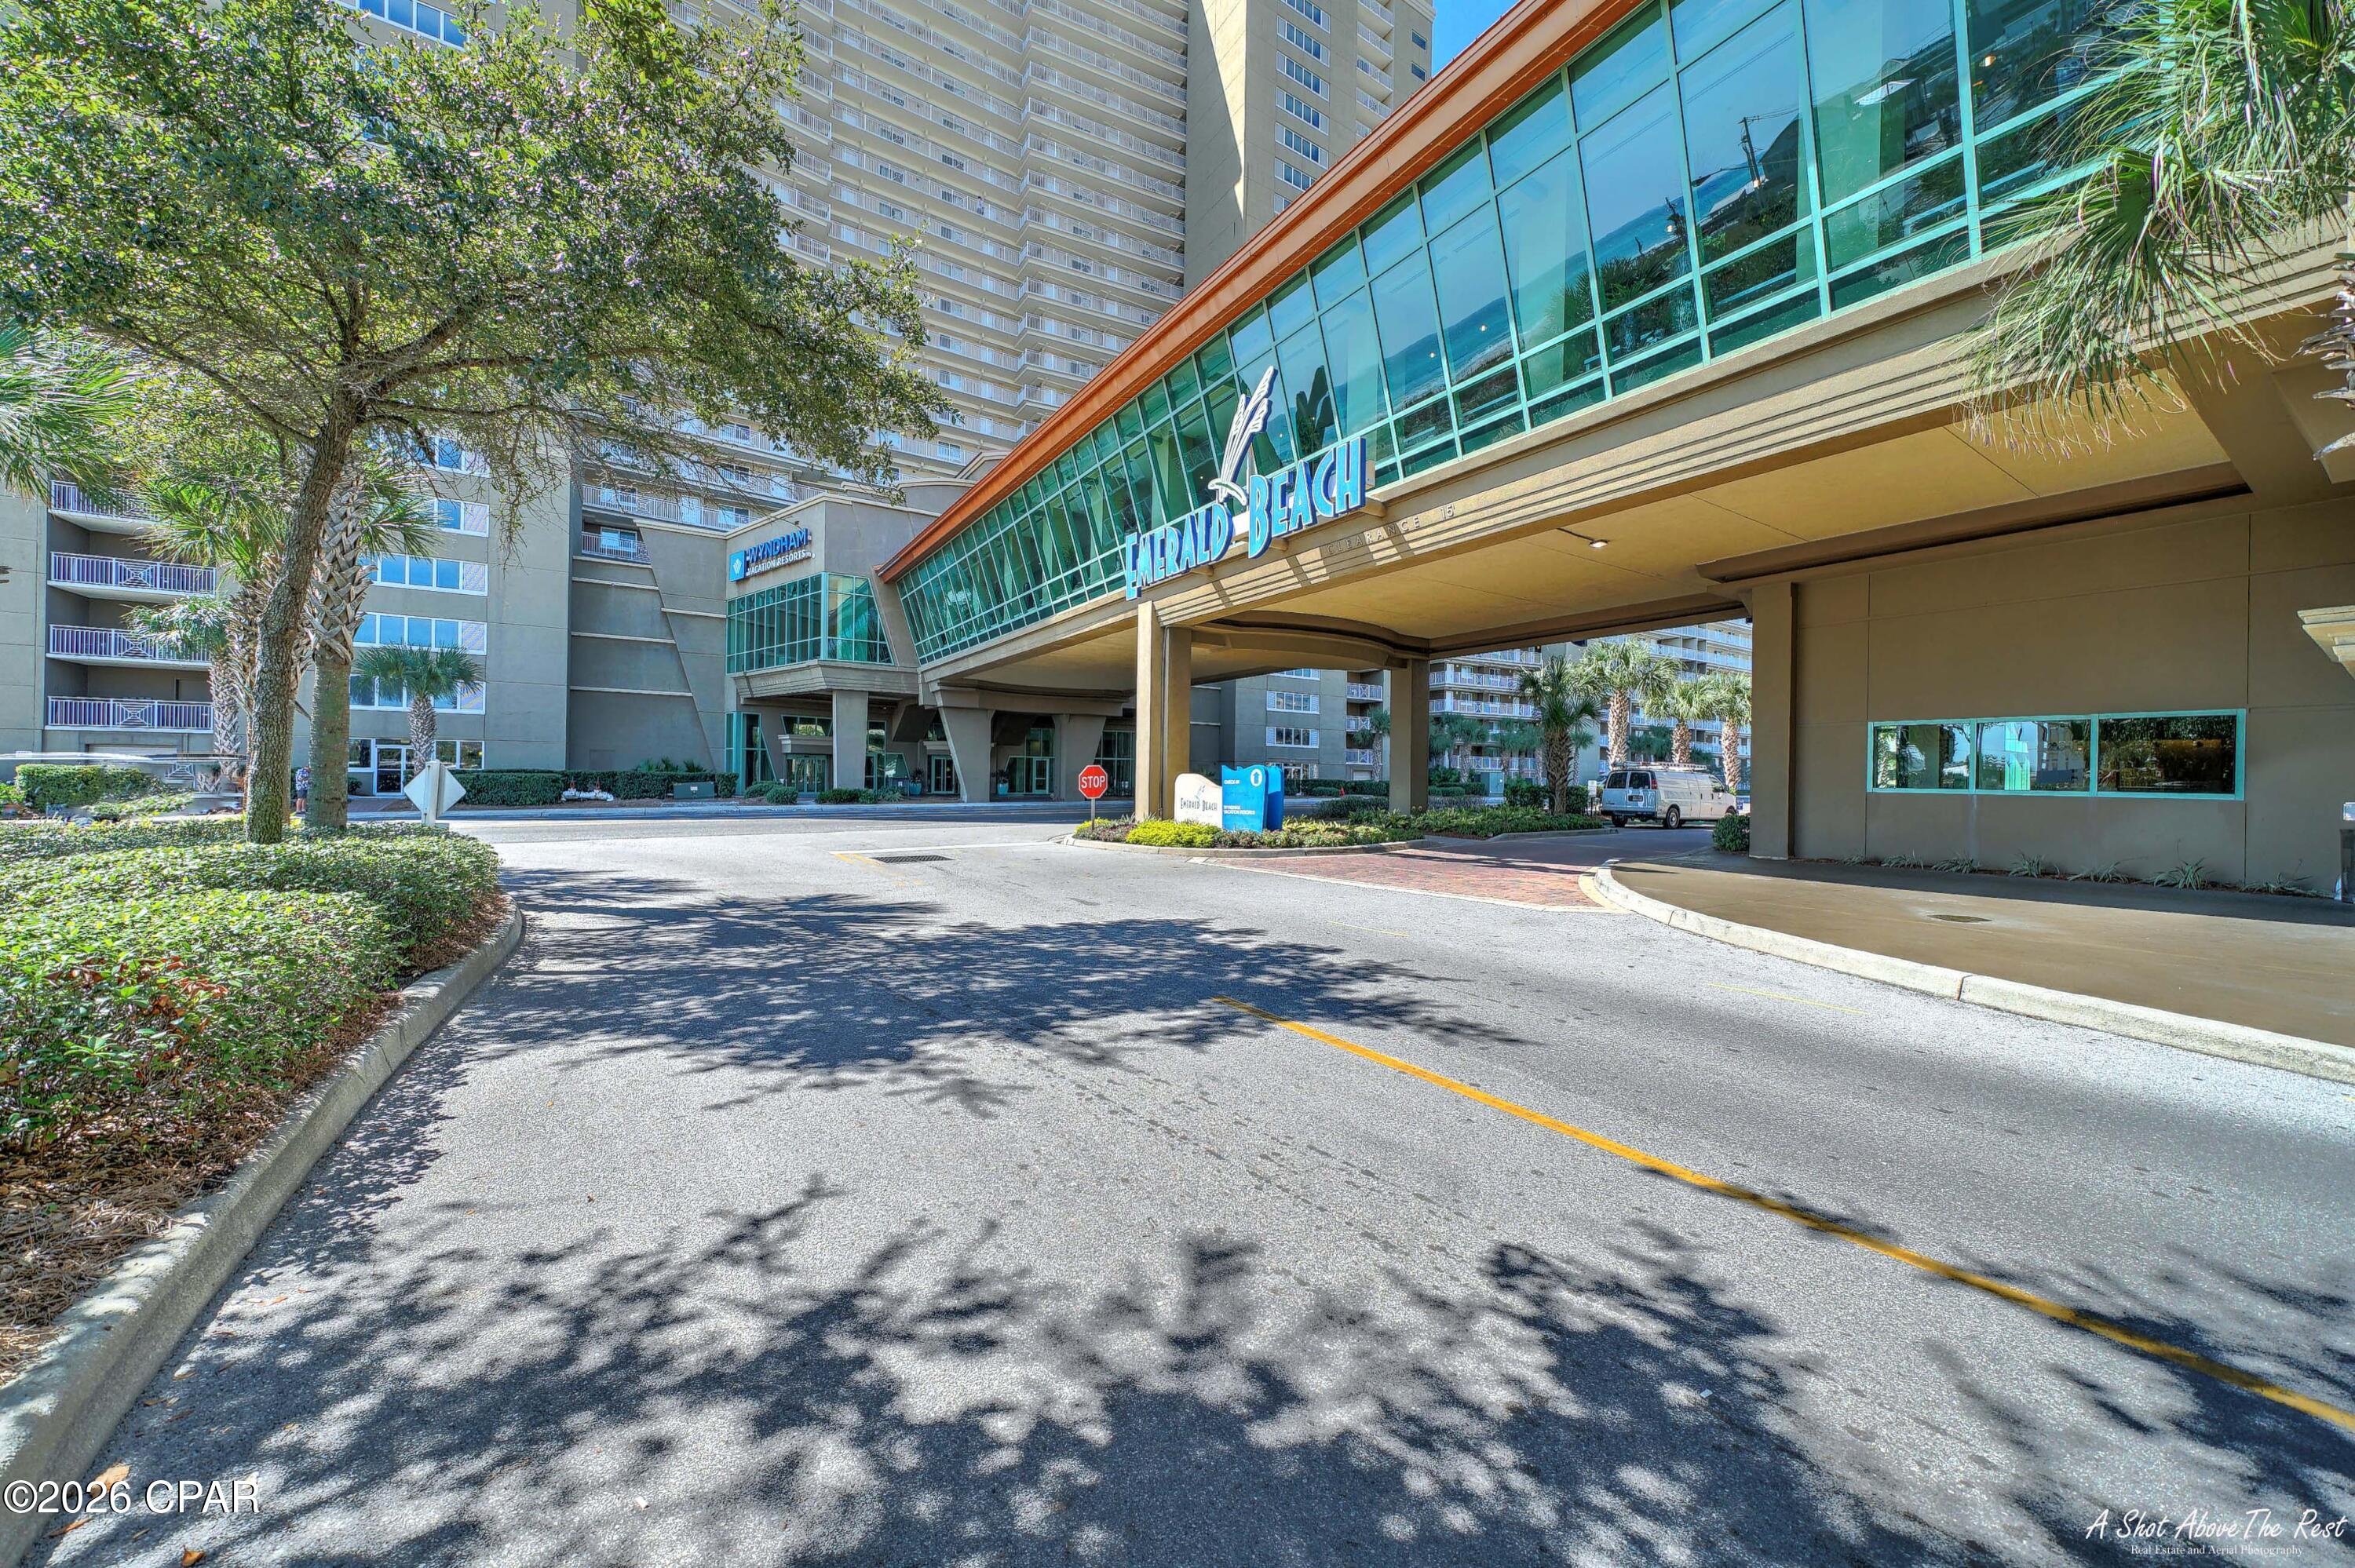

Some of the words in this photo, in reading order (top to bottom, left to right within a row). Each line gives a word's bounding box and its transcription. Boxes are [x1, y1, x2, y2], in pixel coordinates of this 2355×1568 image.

[1126, 502, 1234, 601] EMERALD
[1248, 436, 1367, 559] BEACH
[747, 527, 809, 563] WYNDHAM
[1326, 516, 1421, 554] CLEARANCE
[747, 560, 776, 577] VACATION
[776, 549, 806, 567] RESORTS
[1081, 775, 1105, 789] STOP
[1180, 797, 1200, 810] EMERALD
[1202, 800, 1218, 811] BEACH
